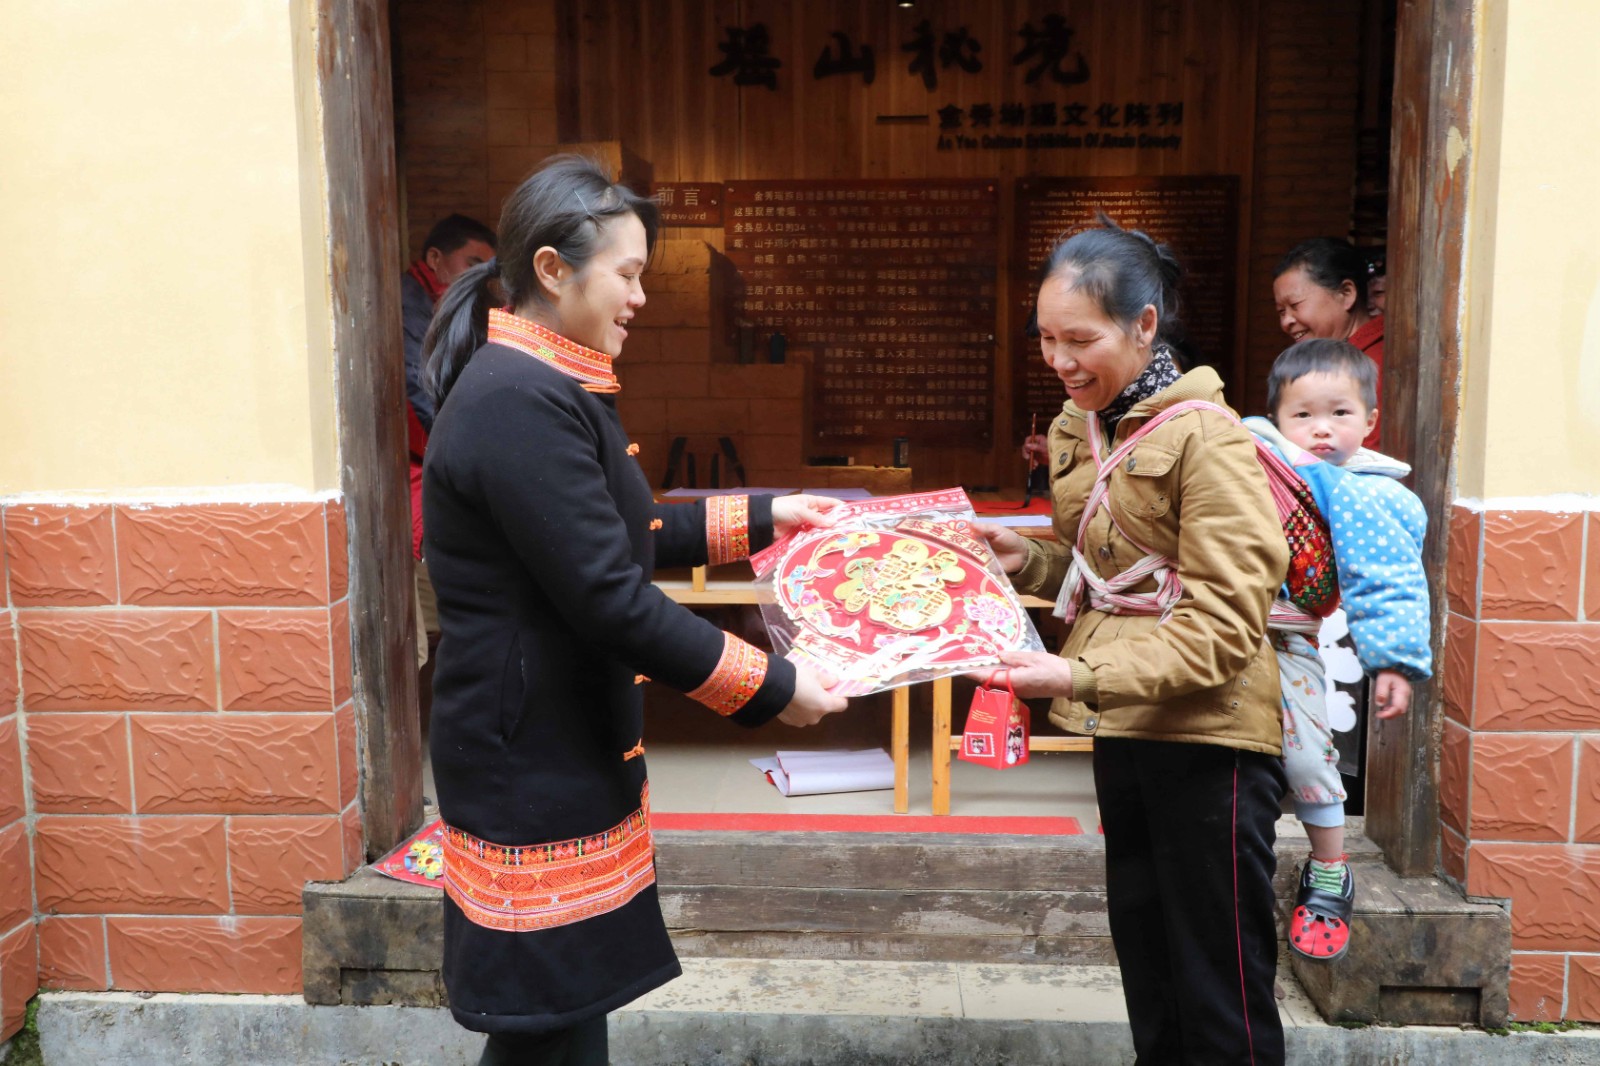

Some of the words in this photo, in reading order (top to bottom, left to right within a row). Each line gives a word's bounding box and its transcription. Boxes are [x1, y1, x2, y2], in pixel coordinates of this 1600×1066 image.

[709, 13, 1090, 91] 瑶山秘境
[656, 186, 700, 206] 前言
[660, 212, 707, 220] reword
